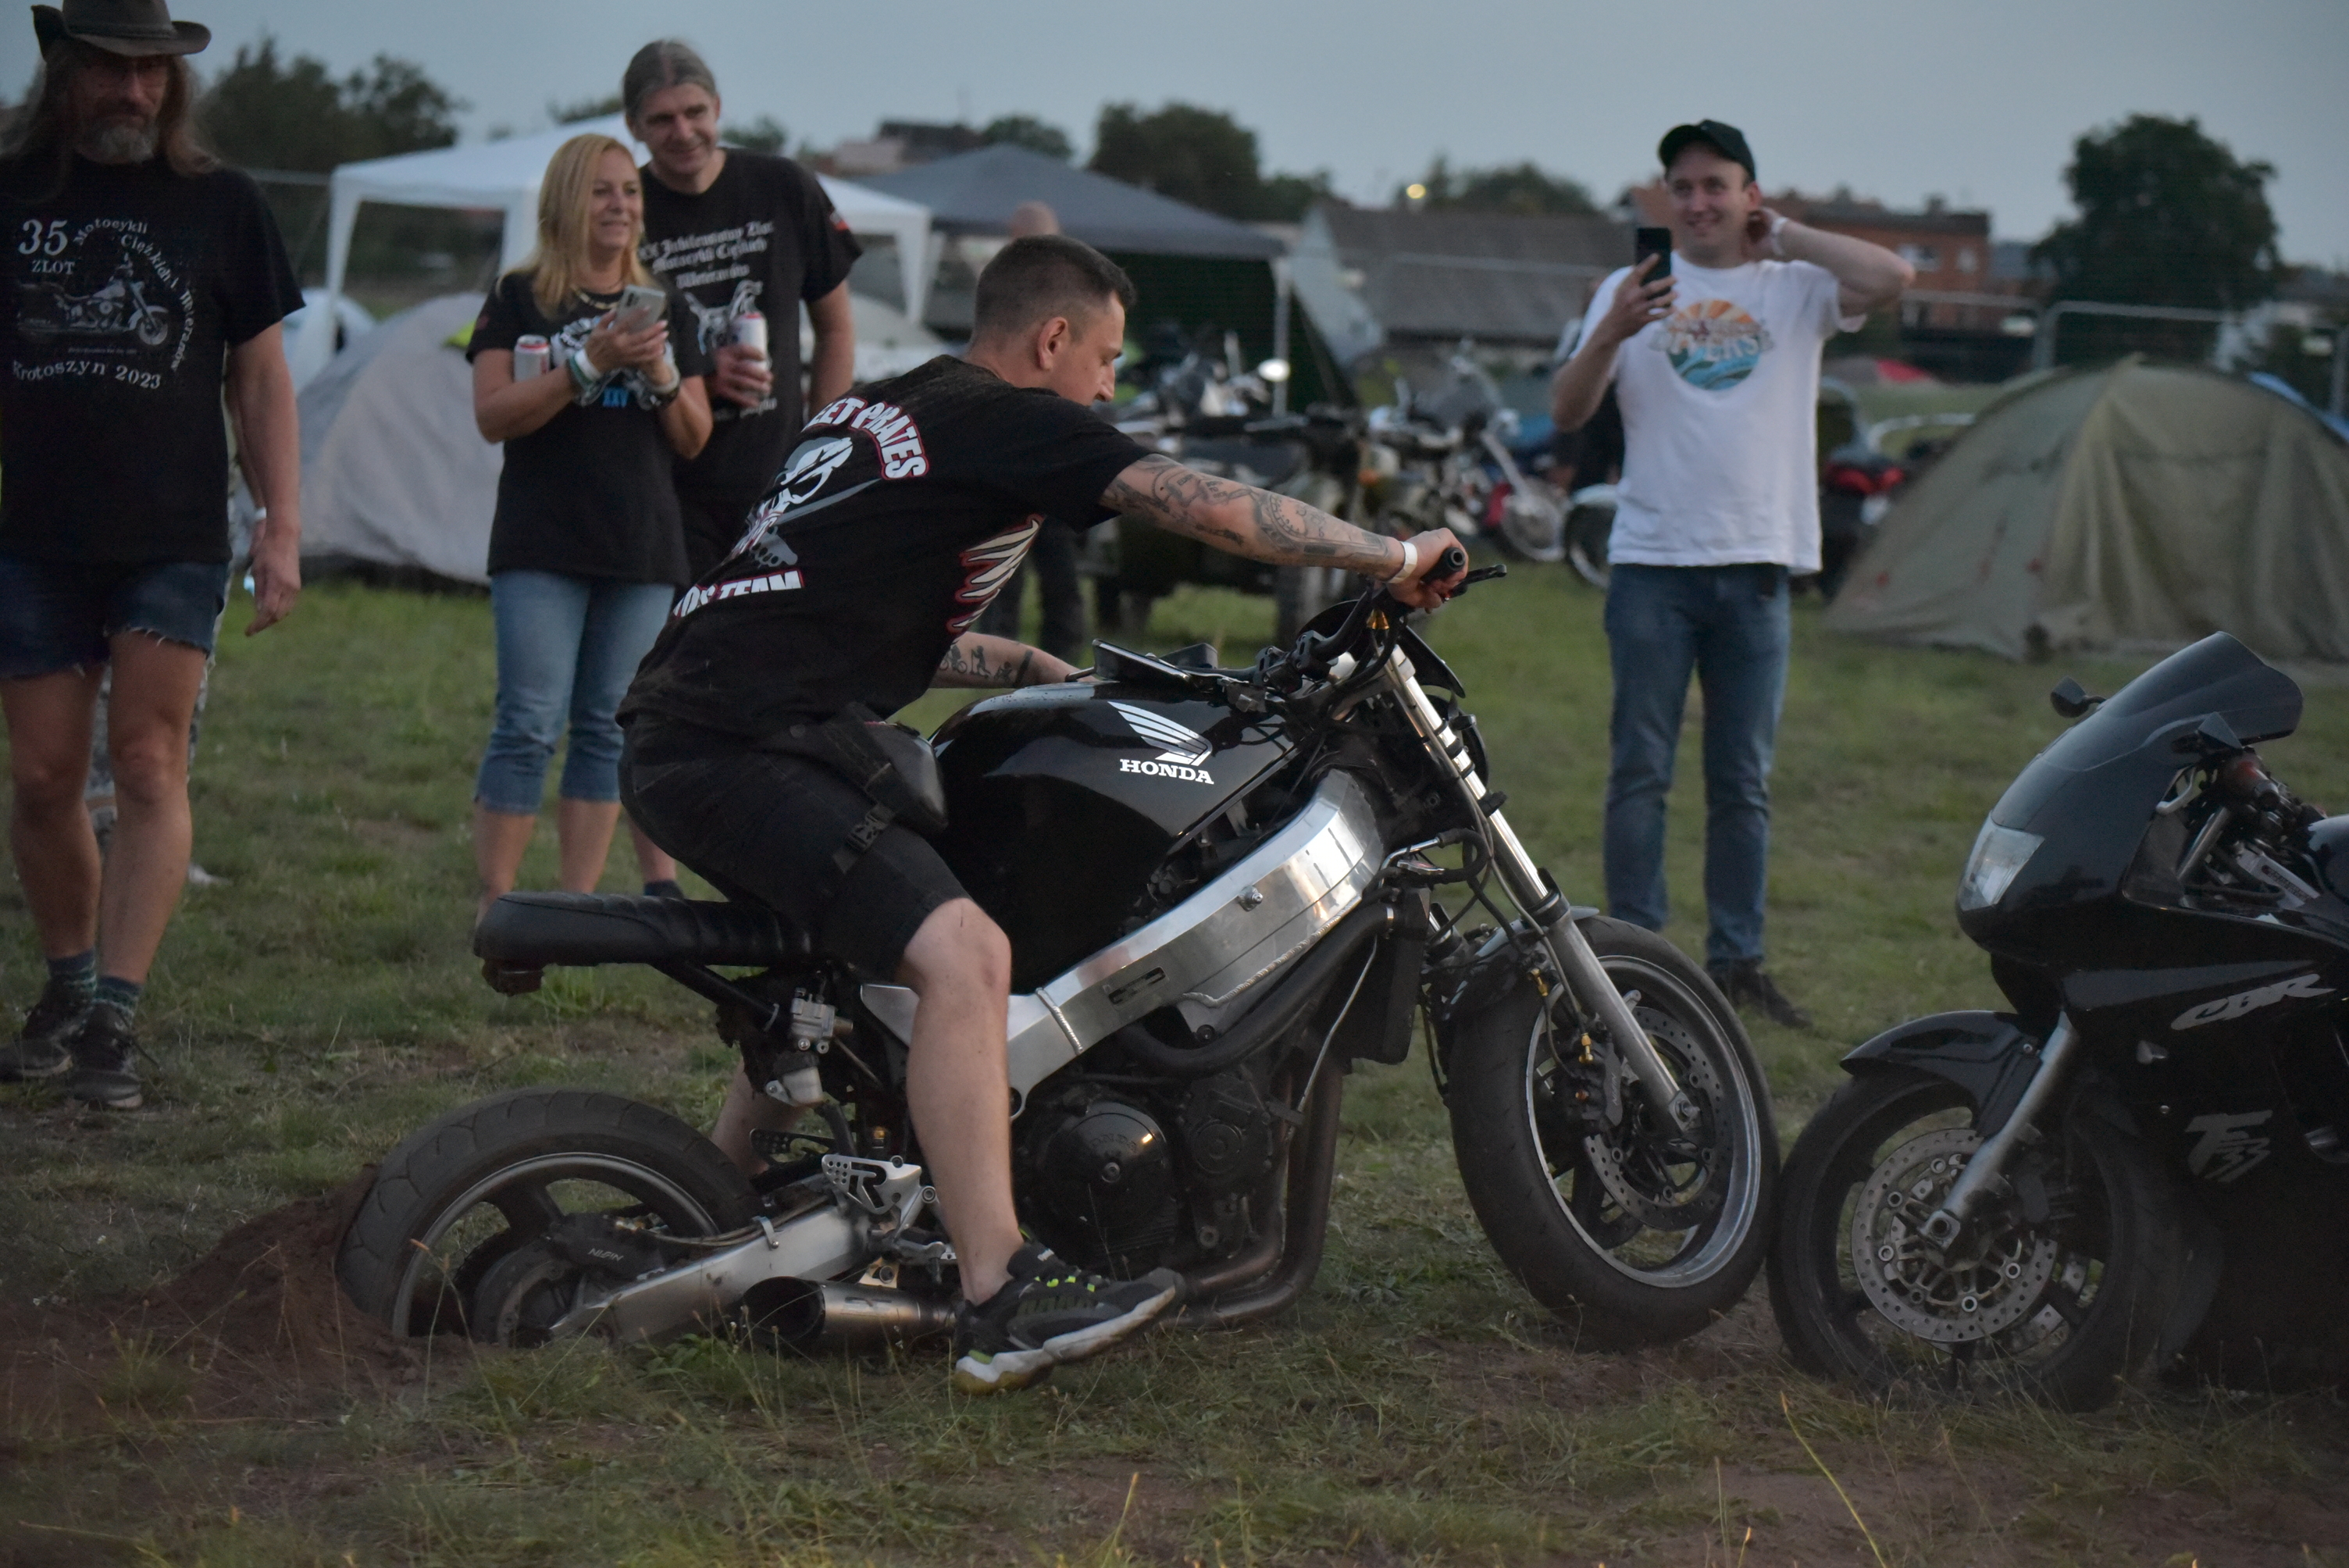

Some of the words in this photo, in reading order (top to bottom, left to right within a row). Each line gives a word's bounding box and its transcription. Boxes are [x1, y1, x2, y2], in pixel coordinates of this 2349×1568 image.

[18, 219, 69, 255] 35
[31, 259, 76, 274] ZLOT
[12, 359, 107, 381] Krotoszyn
[115, 365, 162, 389] 2023
[718, 570, 802, 600] TEAM
[1119, 758, 1215, 785] HONDA
[2170, 973, 2337, 1031] CBR
